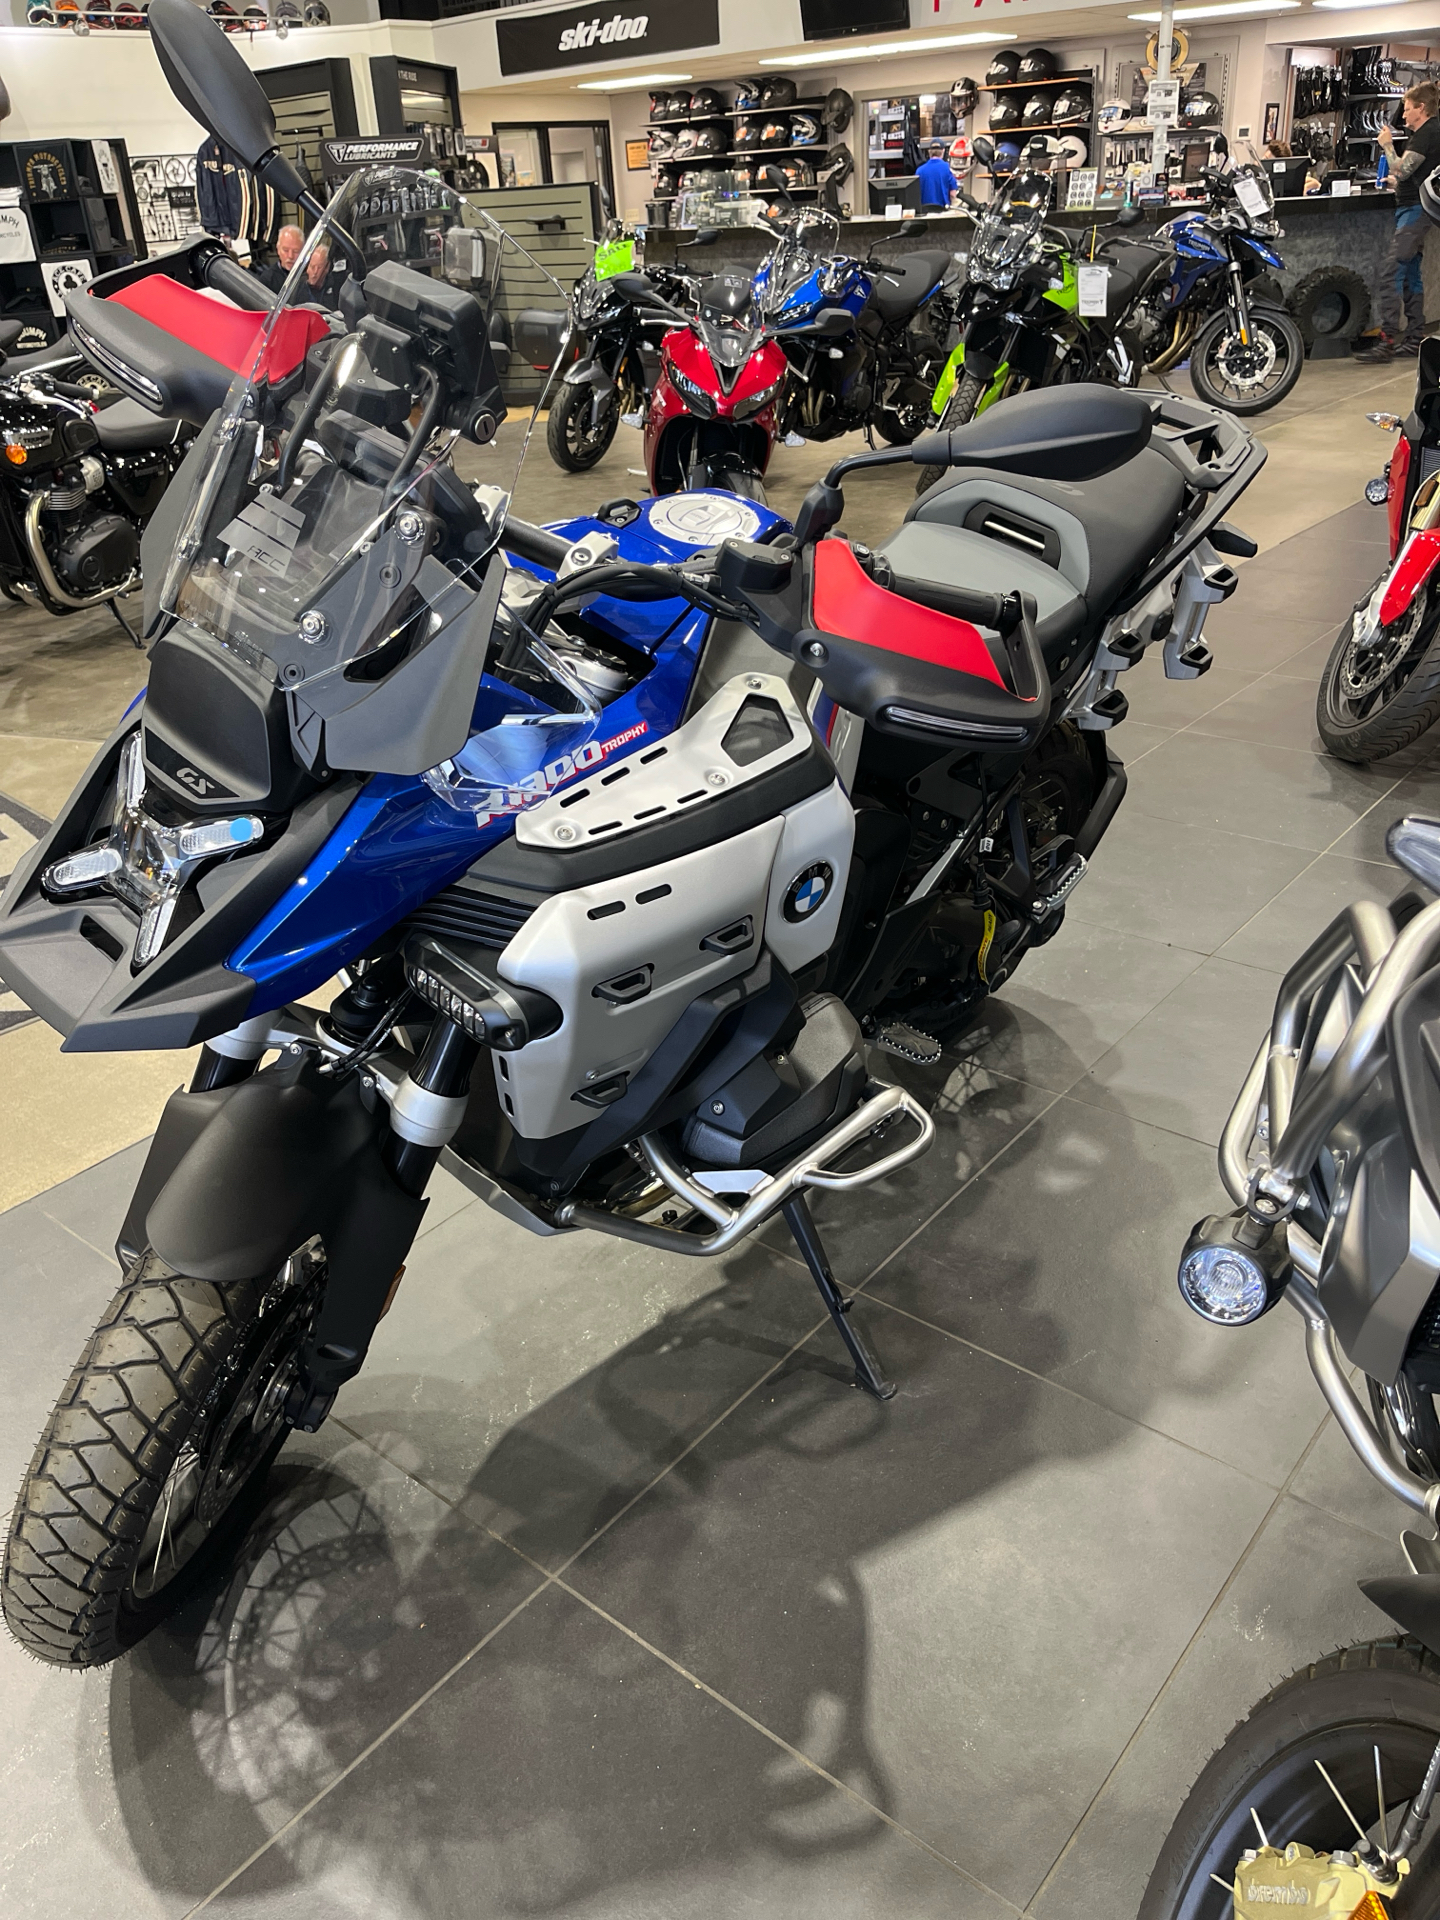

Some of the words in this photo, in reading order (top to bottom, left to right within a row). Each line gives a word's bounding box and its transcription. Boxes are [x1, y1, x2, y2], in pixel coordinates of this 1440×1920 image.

[558, 14, 649, 51] ski-doo
[343, 151, 397, 161] LUBRICANTS
[347, 141, 419, 153] PERFORMANCE
[247, 545, 285, 572] ACC
[602, 722, 647, 753] TROPHY
[176, 767, 216, 795] GS
[1248, 1877, 1311, 1905] brembo
